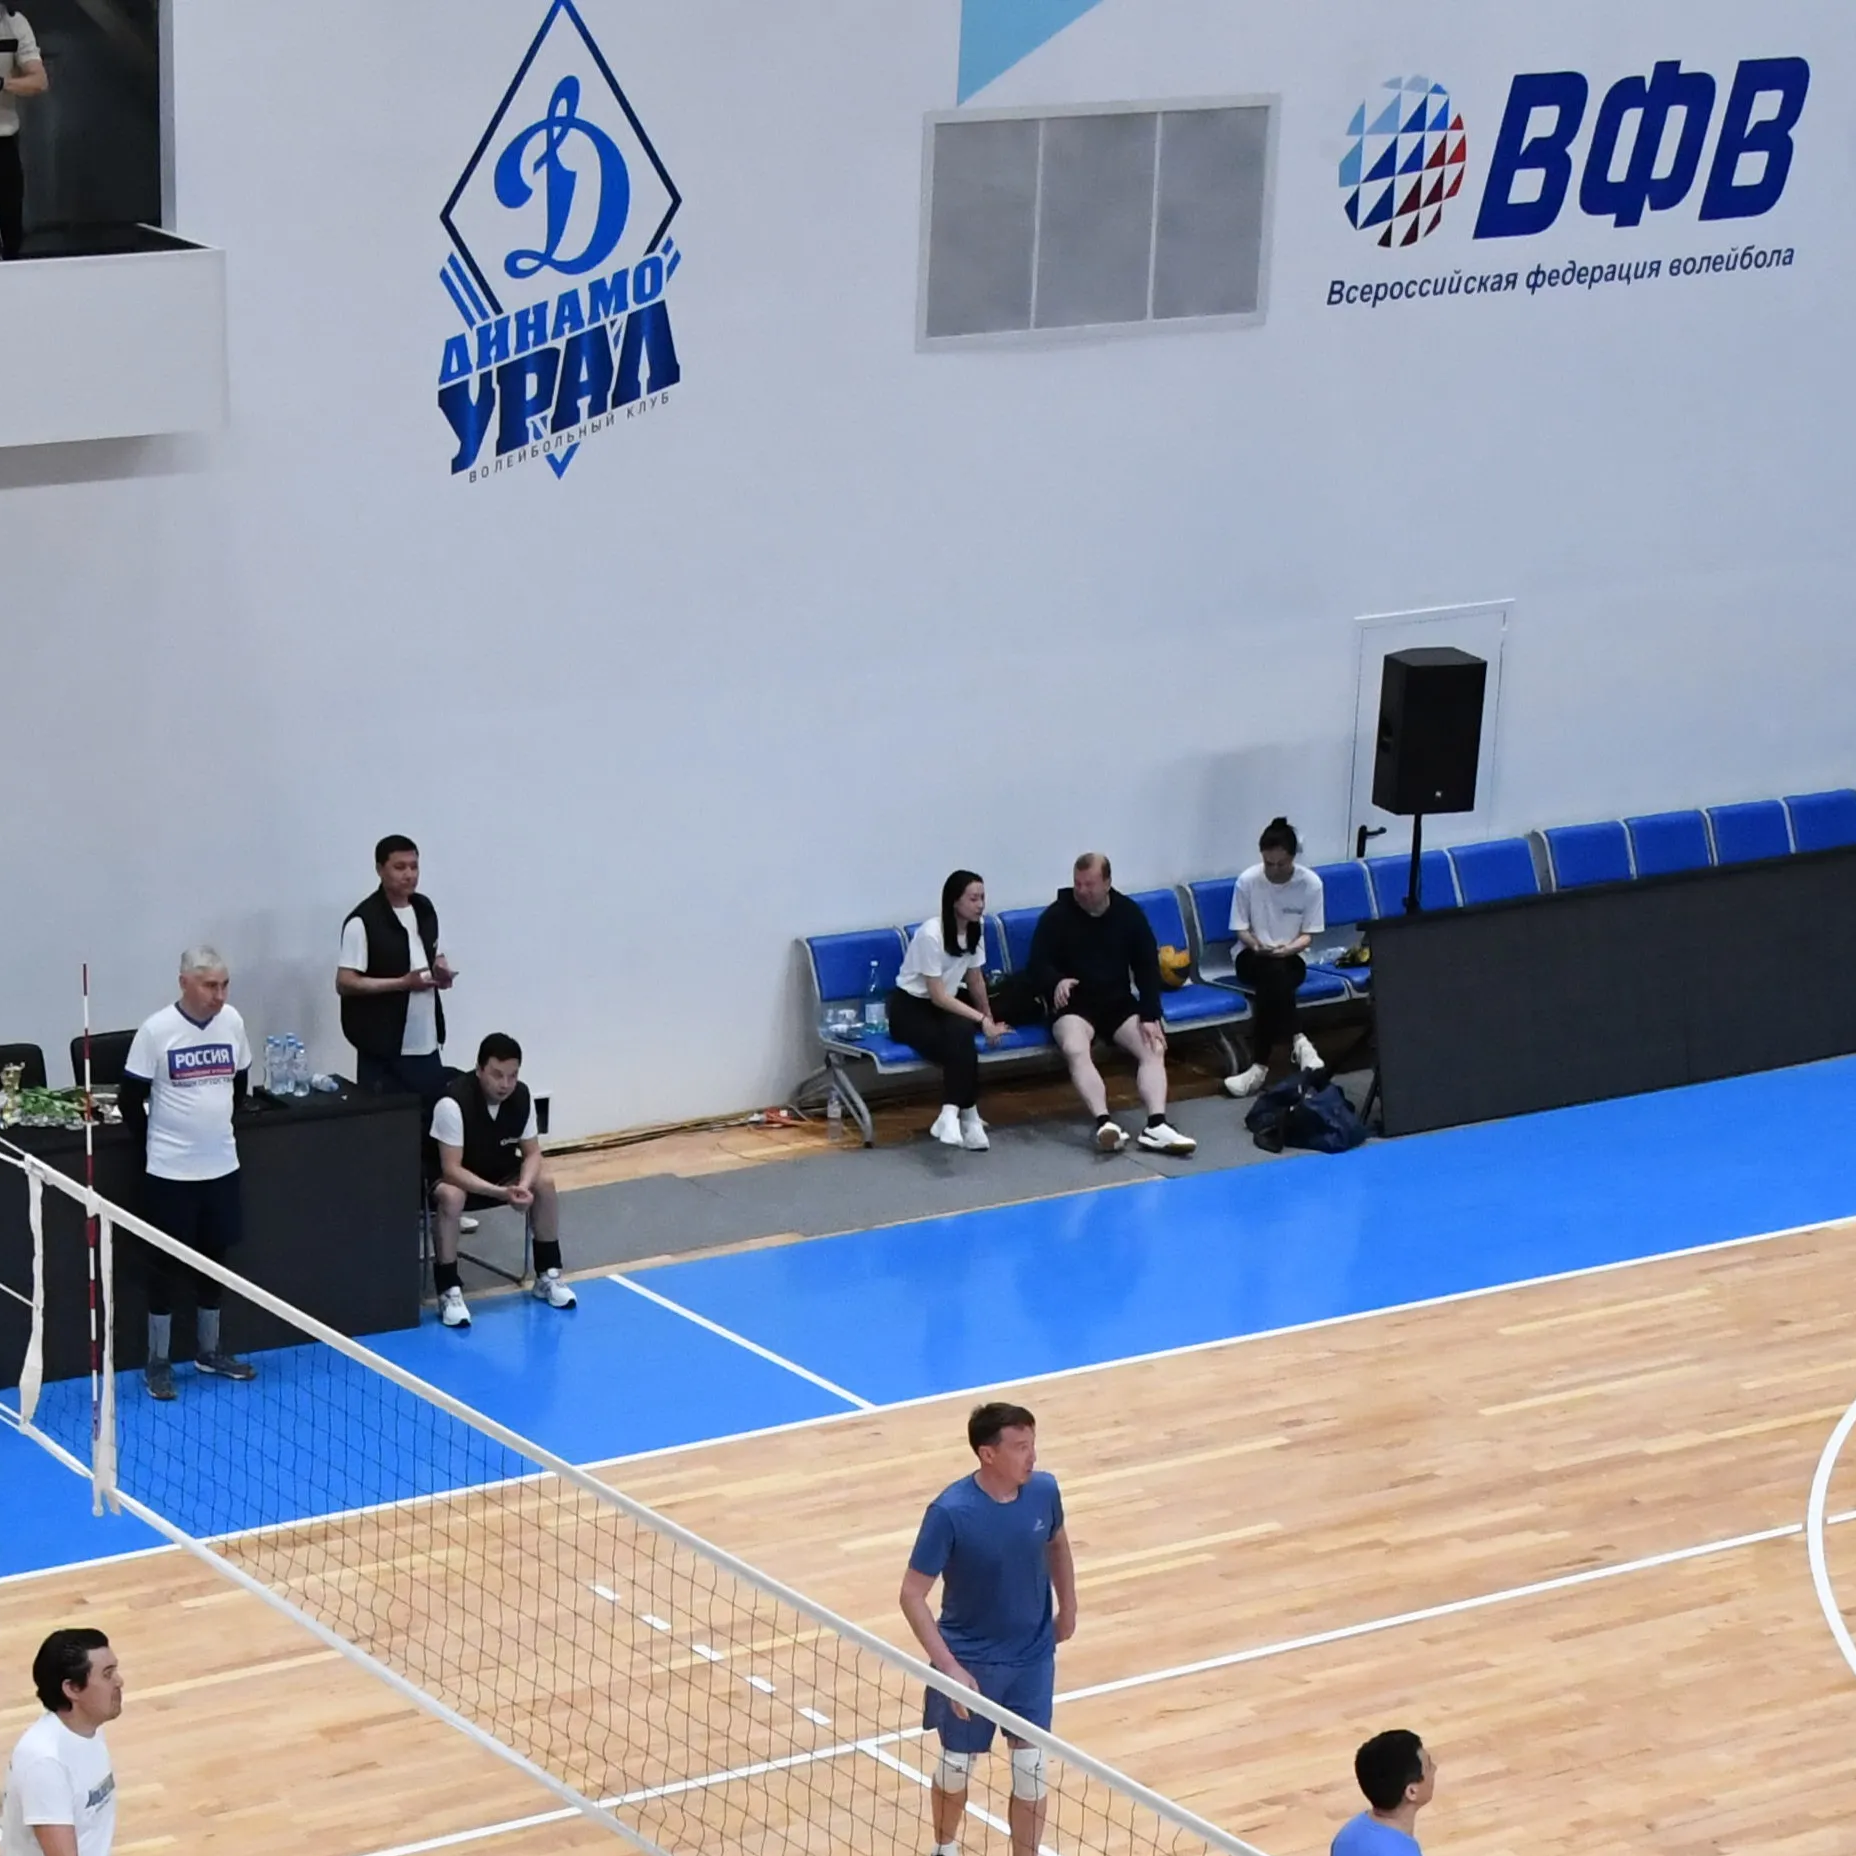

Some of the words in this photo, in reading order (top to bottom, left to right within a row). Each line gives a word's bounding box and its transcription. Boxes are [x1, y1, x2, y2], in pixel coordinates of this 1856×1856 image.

[1472, 56, 1811, 240] ВФВ
[439, 255, 663, 386] ДИНАМО
[1326, 270, 1518, 308] Всероссийская
[1525, 256, 1662, 295] федерация
[1668, 245, 1795, 277] волейбола
[438, 299, 681, 476] УРАЛ
[469, 412, 616, 484] ВОЛЕЙБОЛЬНЫЙ
[626, 391, 670, 419] КЛУБ
[175, 1048, 231, 1069] РОССИЯ
